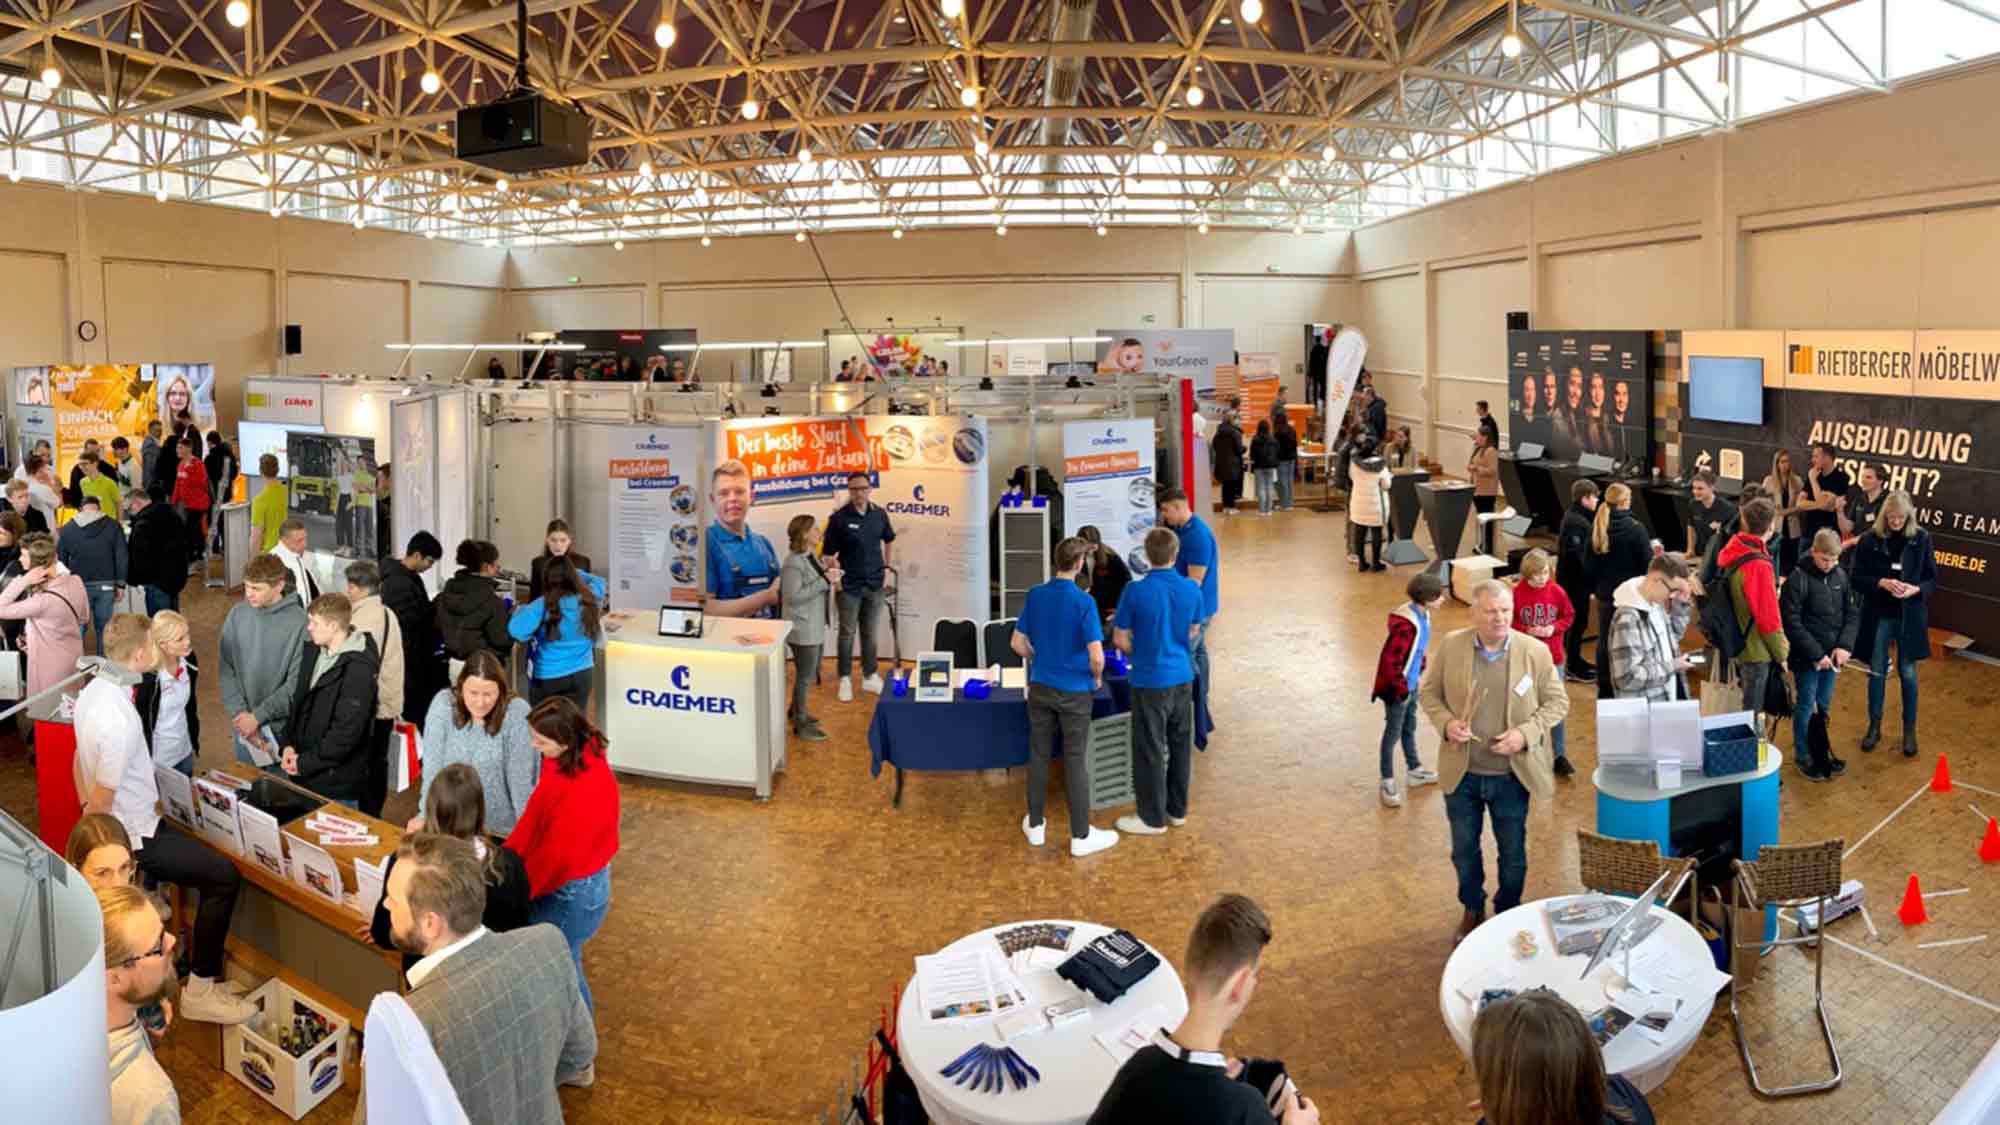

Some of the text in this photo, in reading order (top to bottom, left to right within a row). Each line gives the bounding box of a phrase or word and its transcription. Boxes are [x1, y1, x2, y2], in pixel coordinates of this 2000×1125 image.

[1817, 349, 1912, 380] RIETBERGER
[735, 421, 850, 459] Der beste Start
[1807, 420, 1973, 464] AUSBILDUNG
[752, 460, 770, 478] in
[771, 453, 810, 474] deine
[886, 503, 950, 517] CRAEMER
[1952, 512, 2000, 535] TEAM
[626, 688, 737, 715] CRAEMER
